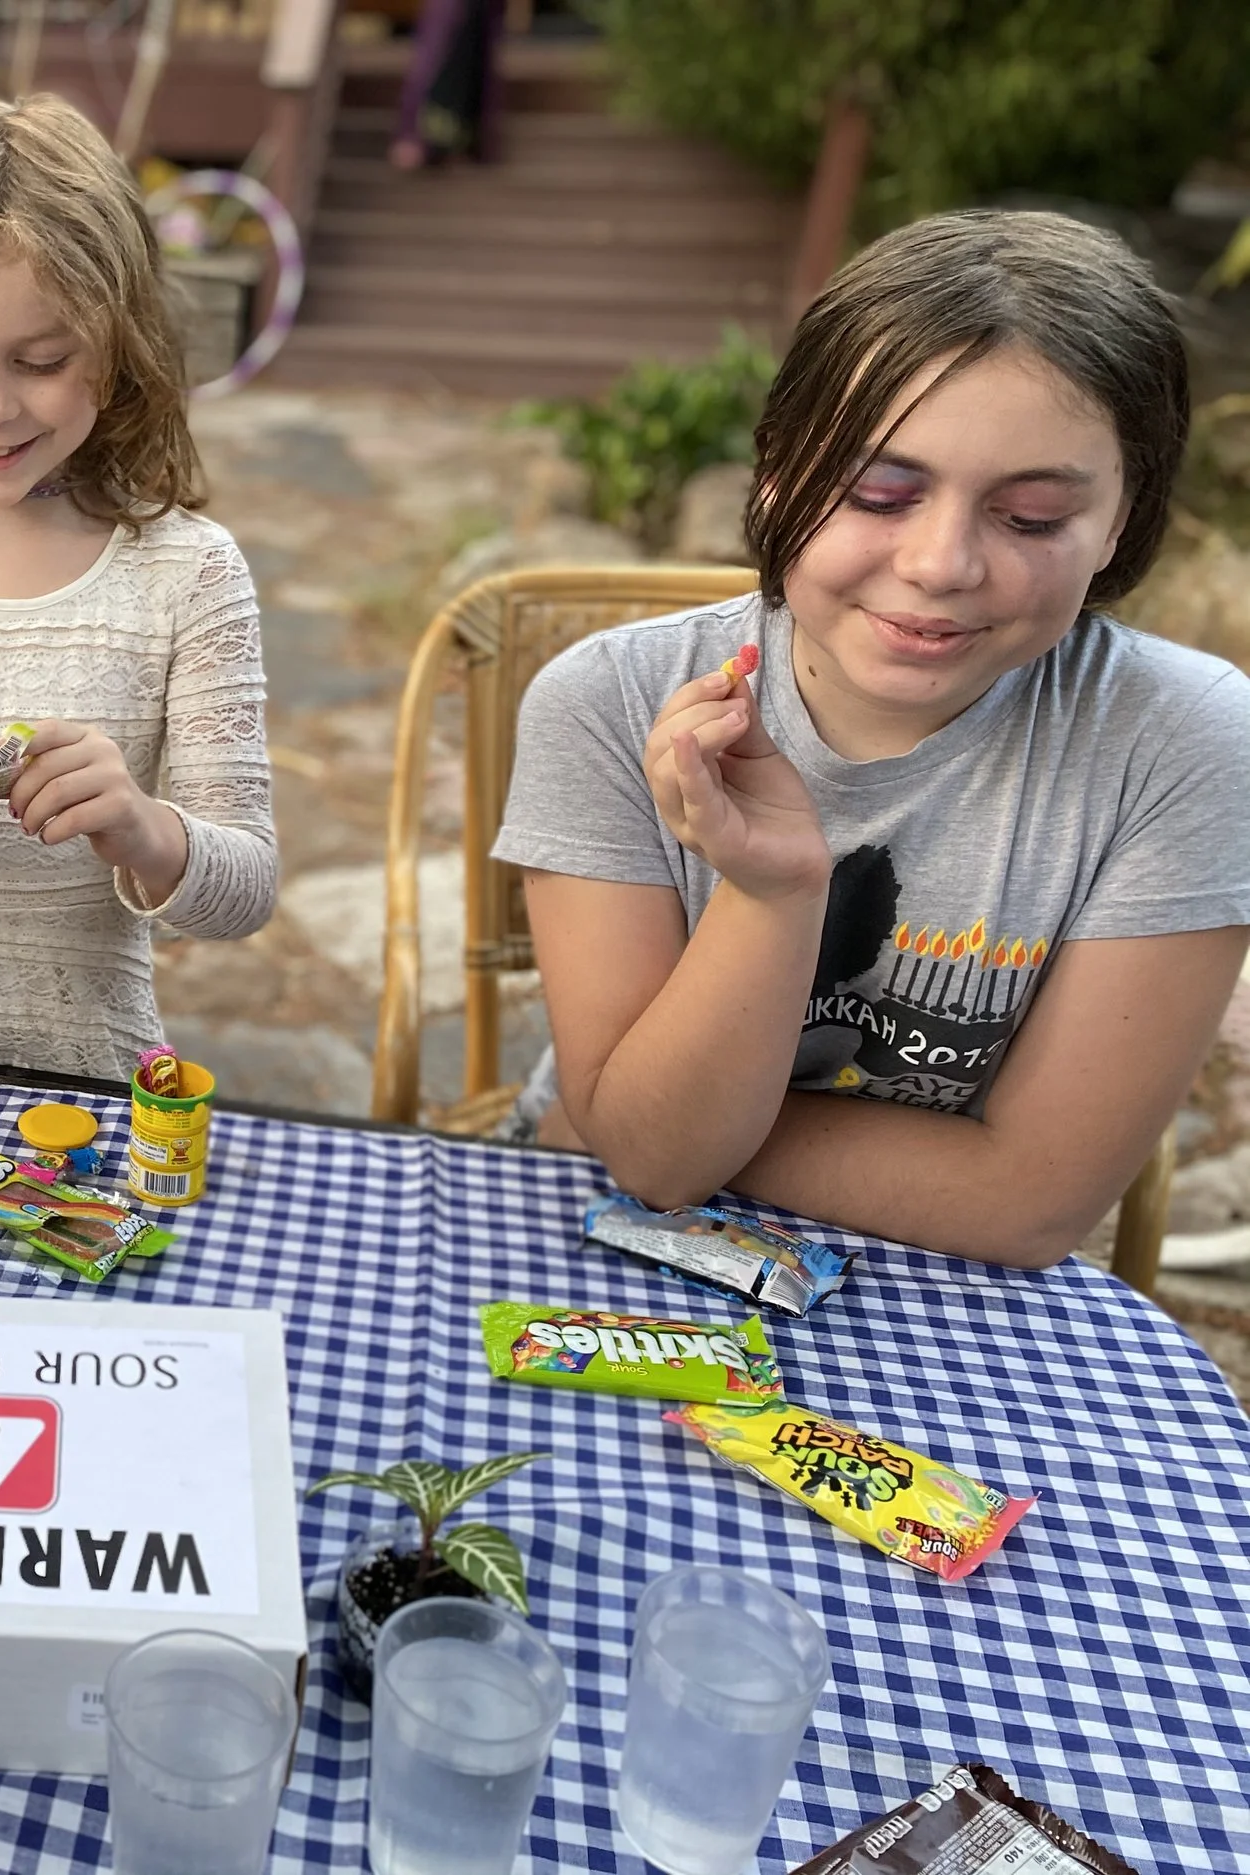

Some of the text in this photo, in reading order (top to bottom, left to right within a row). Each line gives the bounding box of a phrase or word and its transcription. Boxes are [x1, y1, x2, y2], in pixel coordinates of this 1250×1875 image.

[527, 1322, 751, 1373] Skittles
[34, 1351, 180, 1389] SOUR
[774, 1444, 900, 1501] SOUR
[778, 1424, 911, 1477] PATCH
[921, 1538, 958, 1562] SOUR
[1001, 1843, 1025, 1865] 140
